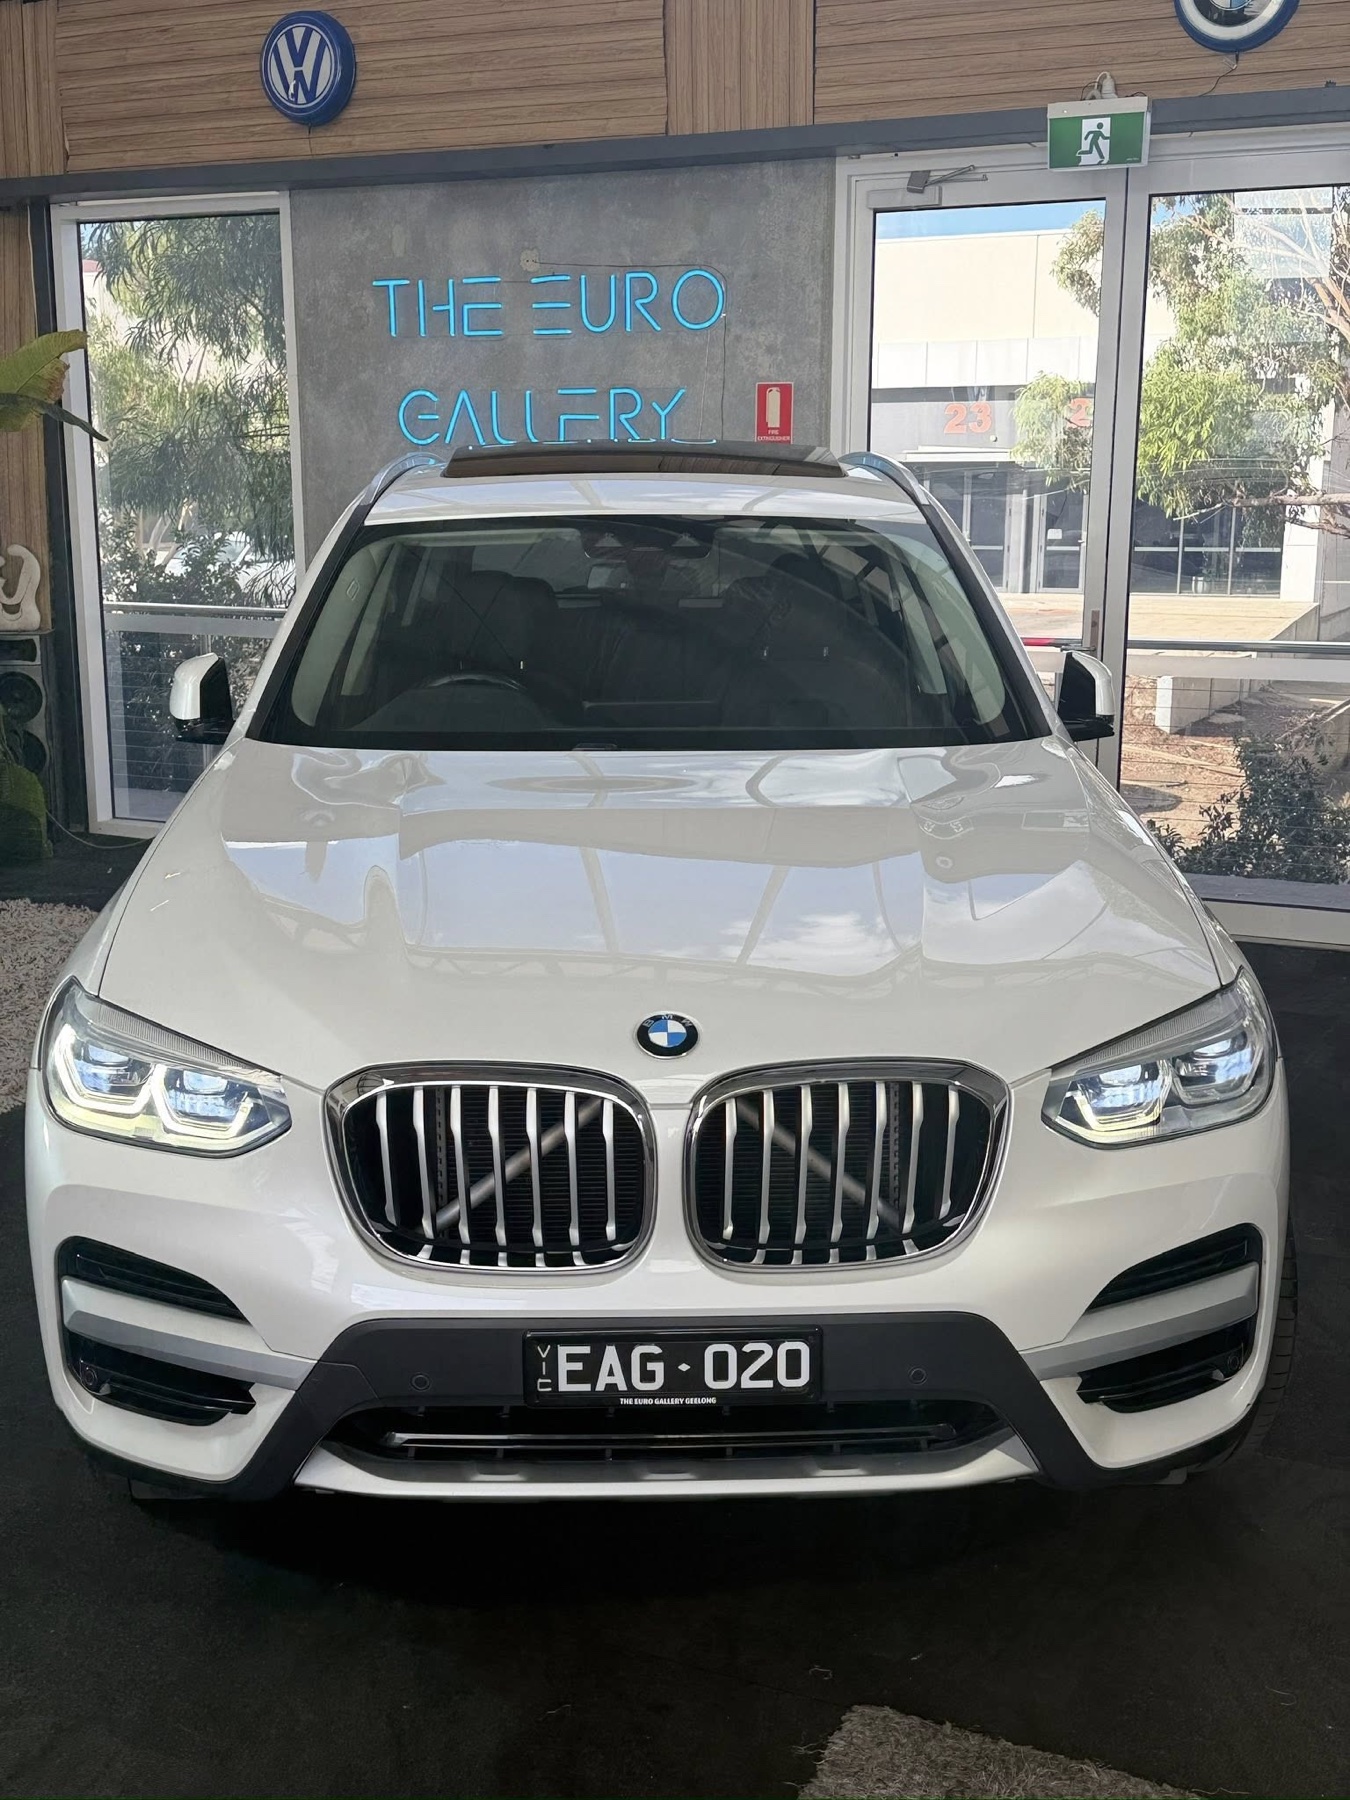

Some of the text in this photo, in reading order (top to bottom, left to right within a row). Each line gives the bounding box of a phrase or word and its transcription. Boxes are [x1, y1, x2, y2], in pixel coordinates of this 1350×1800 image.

[372, 269, 725, 337] THE EURO
[398, 386, 687, 446] GALLERY
[943, 402, 992, 434] 23
[642, 1013, 693, 1027] BMW
[537, 1344, 552, 1392] VIC
[619, 1396, 717, 1405] THE EURO GALLERY GEELONG
